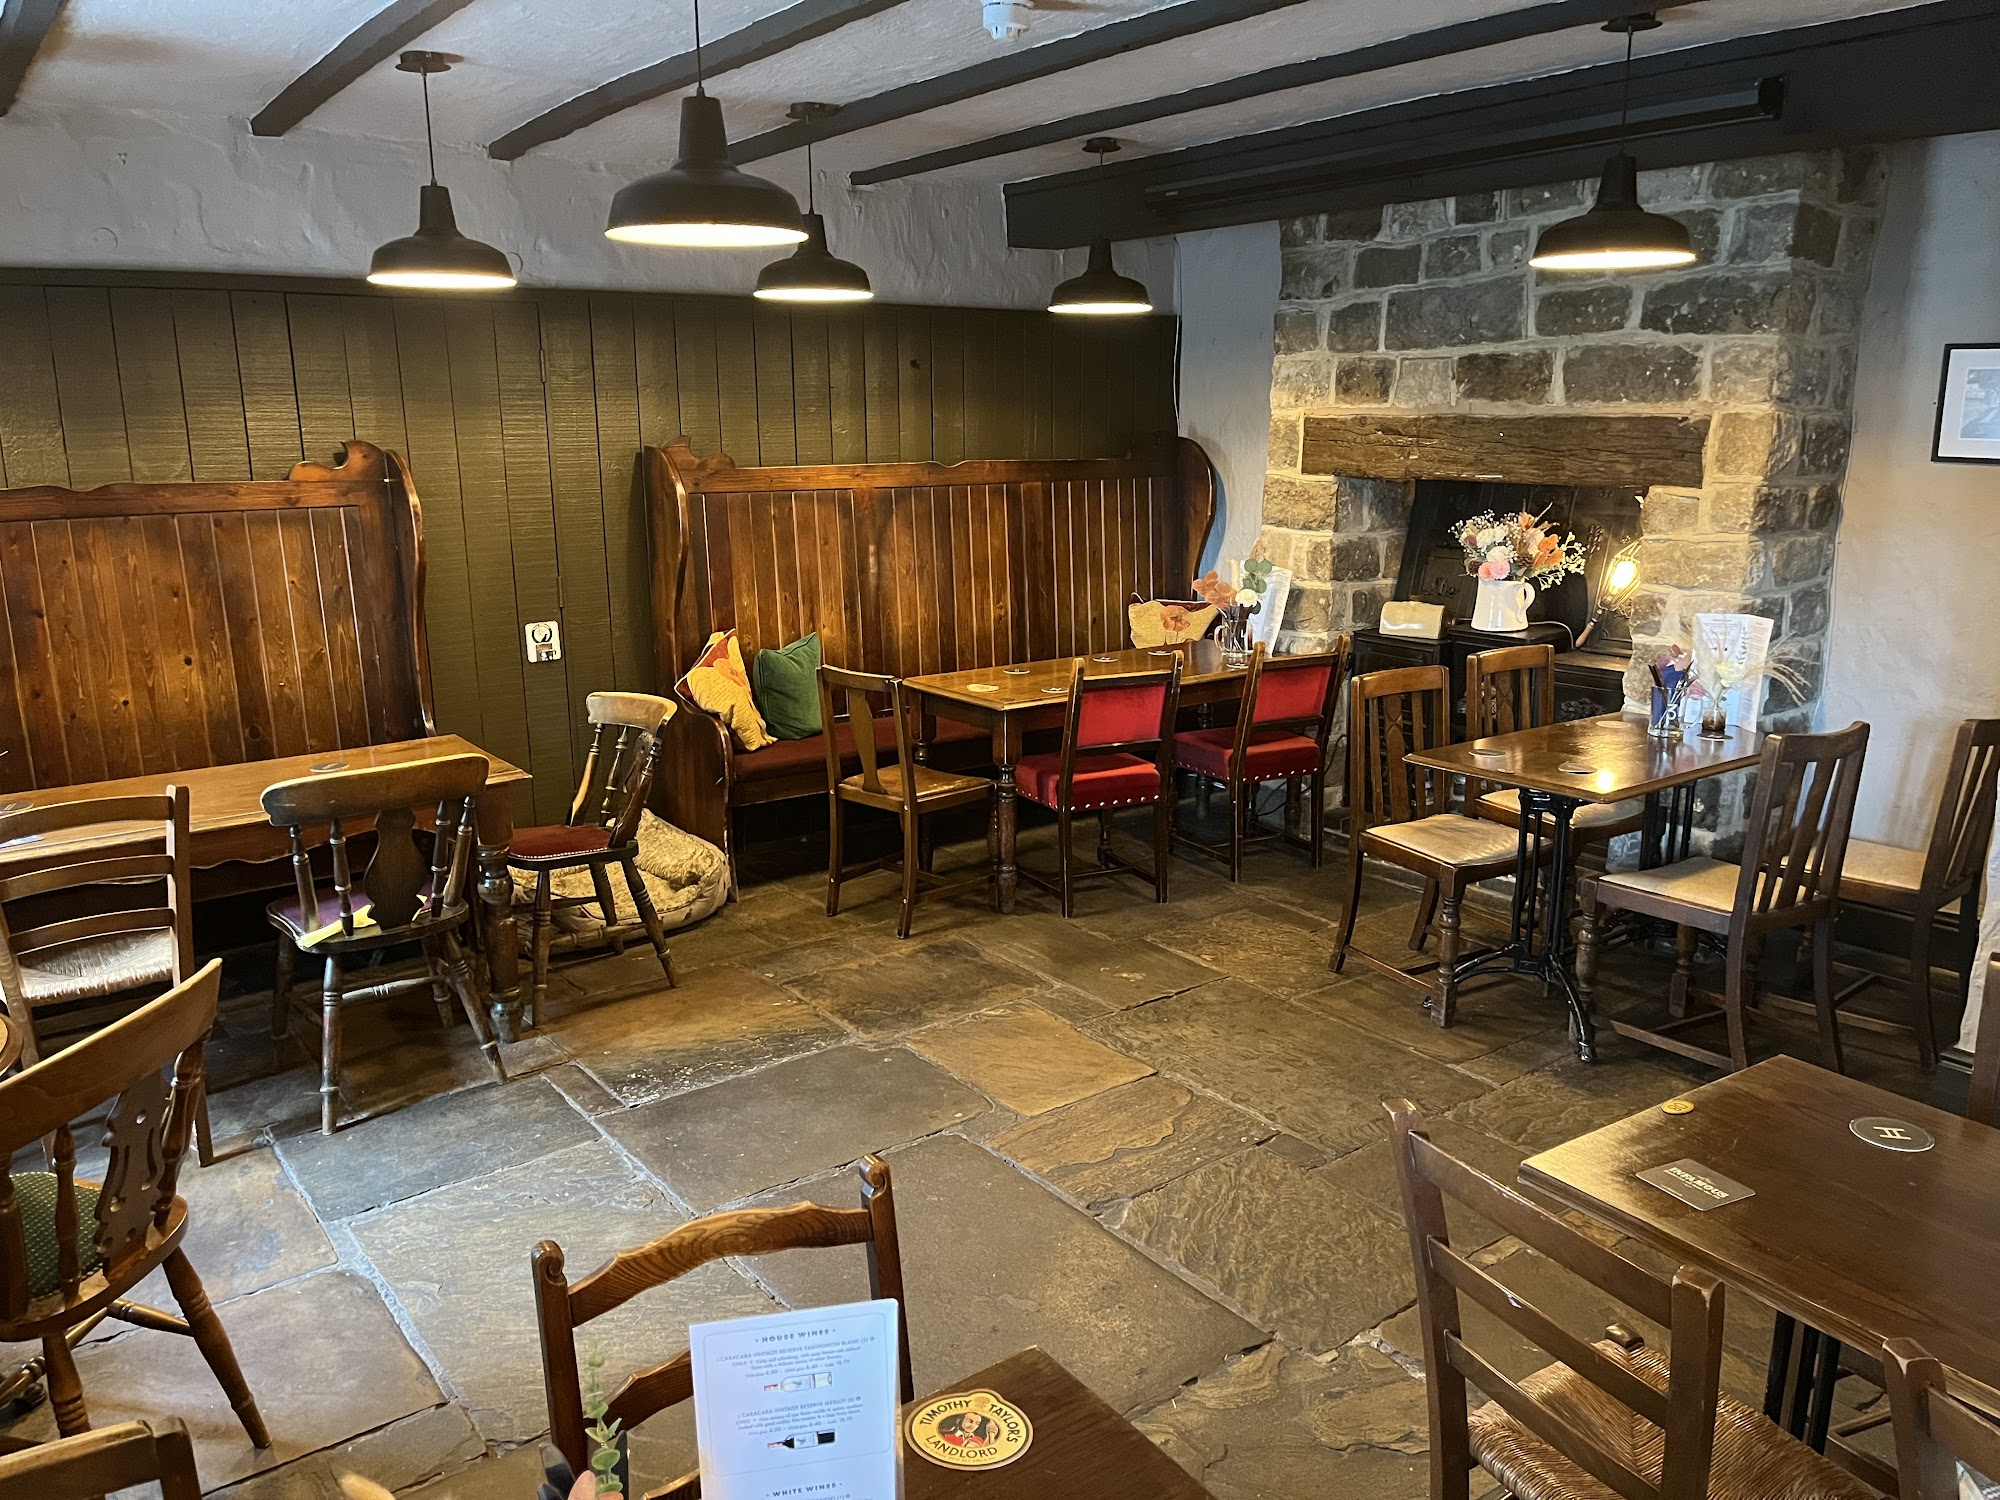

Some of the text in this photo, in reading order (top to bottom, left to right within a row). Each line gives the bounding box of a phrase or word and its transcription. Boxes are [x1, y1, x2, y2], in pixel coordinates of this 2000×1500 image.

[1668, 1166, 1730, 1199] INFAMOUS
[761, 1329, 830, 1343] HOUSE WINES
[741, 1409, 773, 1418] CARACARA
[774, 1405, 799, 1413] VINTAGE
[920, 1400, 972, 1425] TIMOTHY
[988, 1404, 1022, 1444] TAYLOR'S
[926, 1435, 998, 1459] LANDLORD
[773, 1487, 802, 1497] WHITE
[805, 1482, 837, 1492] WINES
